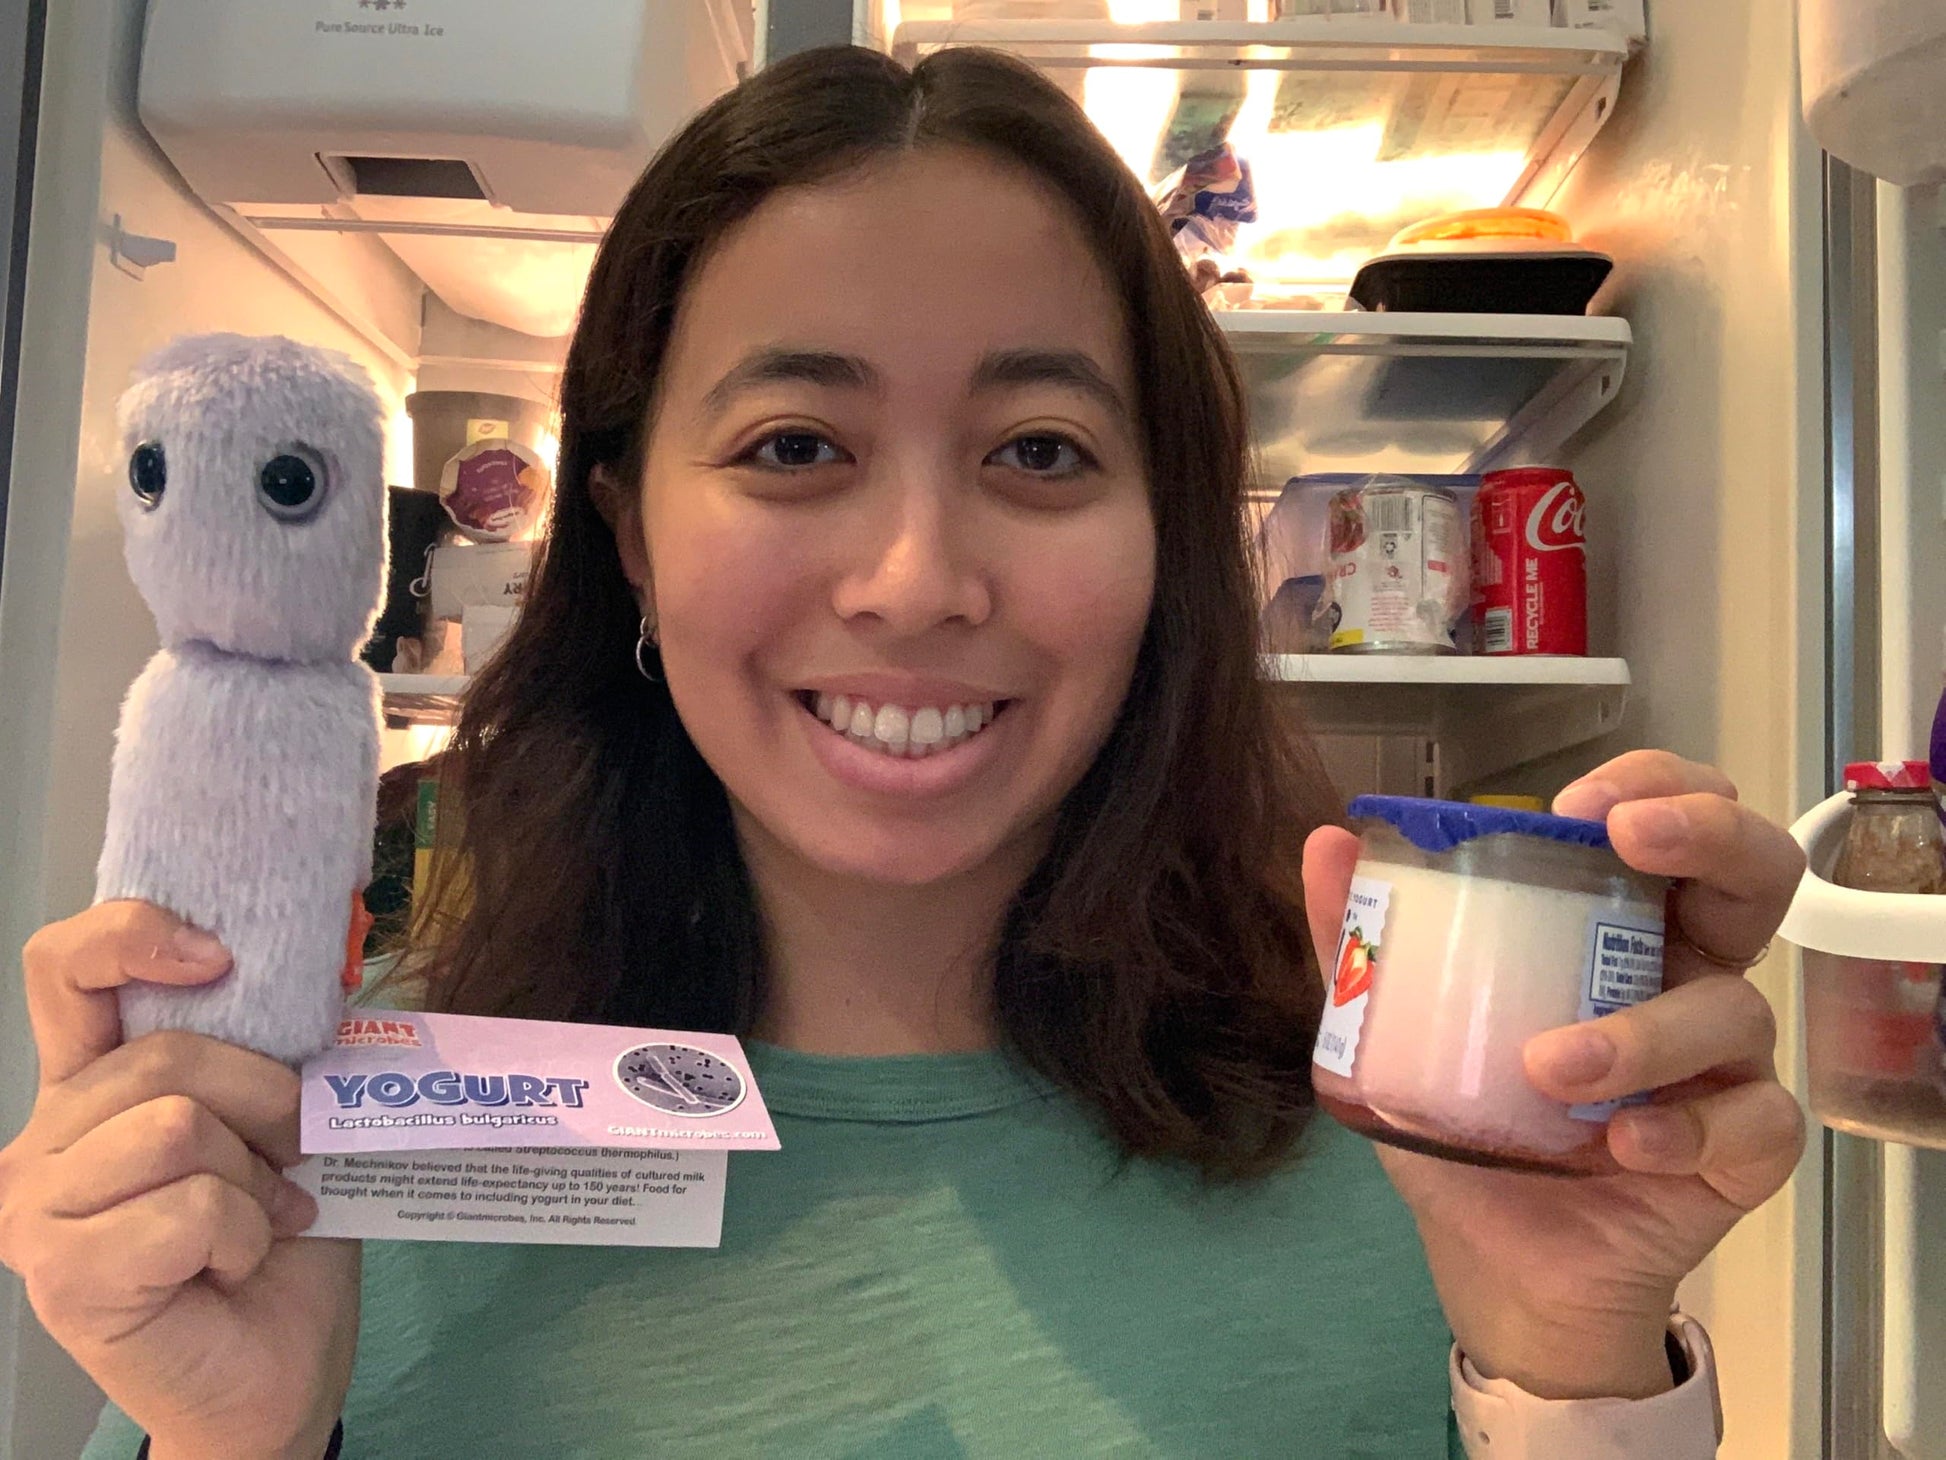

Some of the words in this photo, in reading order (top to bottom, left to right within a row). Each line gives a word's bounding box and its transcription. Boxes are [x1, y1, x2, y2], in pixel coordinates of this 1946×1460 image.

[388, 23, 419, 35] Ultra
[424, 24, 444, 36] Ice
[1525, 557, 1539, 581] ME
[1525, 583, 1539, 650] RECYCLE
[336, 1020, 416, 1038] GIANT
[335, 1036, 422, 1047] microbes
[325, 1072, 589, 1108] YOGURT
[330, 1114, 455, 1129] Lactobacillus
[460, 1113, 558, 1128] bulgaricus
[607, 1126, 767, 1140] GIANTmicrobes.com
[601, 1147, 680, 1161] thermophilus.)
[344, 1157, 409, 1170] Mechnikov
[412, 1161, 461, 1173] believed
[465, 1163, 488, 1174] that
[491, 1164, 509, 1174] the
[512, 1165, 568, 1179] life-giving
[570, 1168, 617, 1180] qualities
[621, 1169, 632, 1178] of
[635, 1170, 680, 1181] cultured
[683, 1172, 705, 1182] milk
[321, 1172, 376, 1184] products
[380, 1174, 415, 1187] might
[418, 1175, 457, 1186] extend
[460, 1177, 548, 1191] life-expectancy
[551, 1182, 566, 1192] up
[569, 1181, 580, 1190] to
[583, 1182, 604, 1191] 150
[605, 1183, 640, 1194] years!
[642, 1184, 670, 1194] Food
[672, 1185, 687, 1194] for
[320, 1186, 368, 1200] thought
[371, 1188, 404, 1199] when
[407, 1188, 415, 1199] it
[418, 1191, 457, 1200] comes
[460, 1191, 472, 1200] to
[475, 1191, 528, 1204] including
[531, 1194, 568, 1205] yogurt
[571, 1195, 581, 1204] in
[584, 1197, 608, 1207] your
[397, 1210, 445, 1222] Copyright
[529, 1215, 546, 1224] Inc.
[548, 1215, 560, 1223] All
[562, 1215, 591, 1226] Rights
